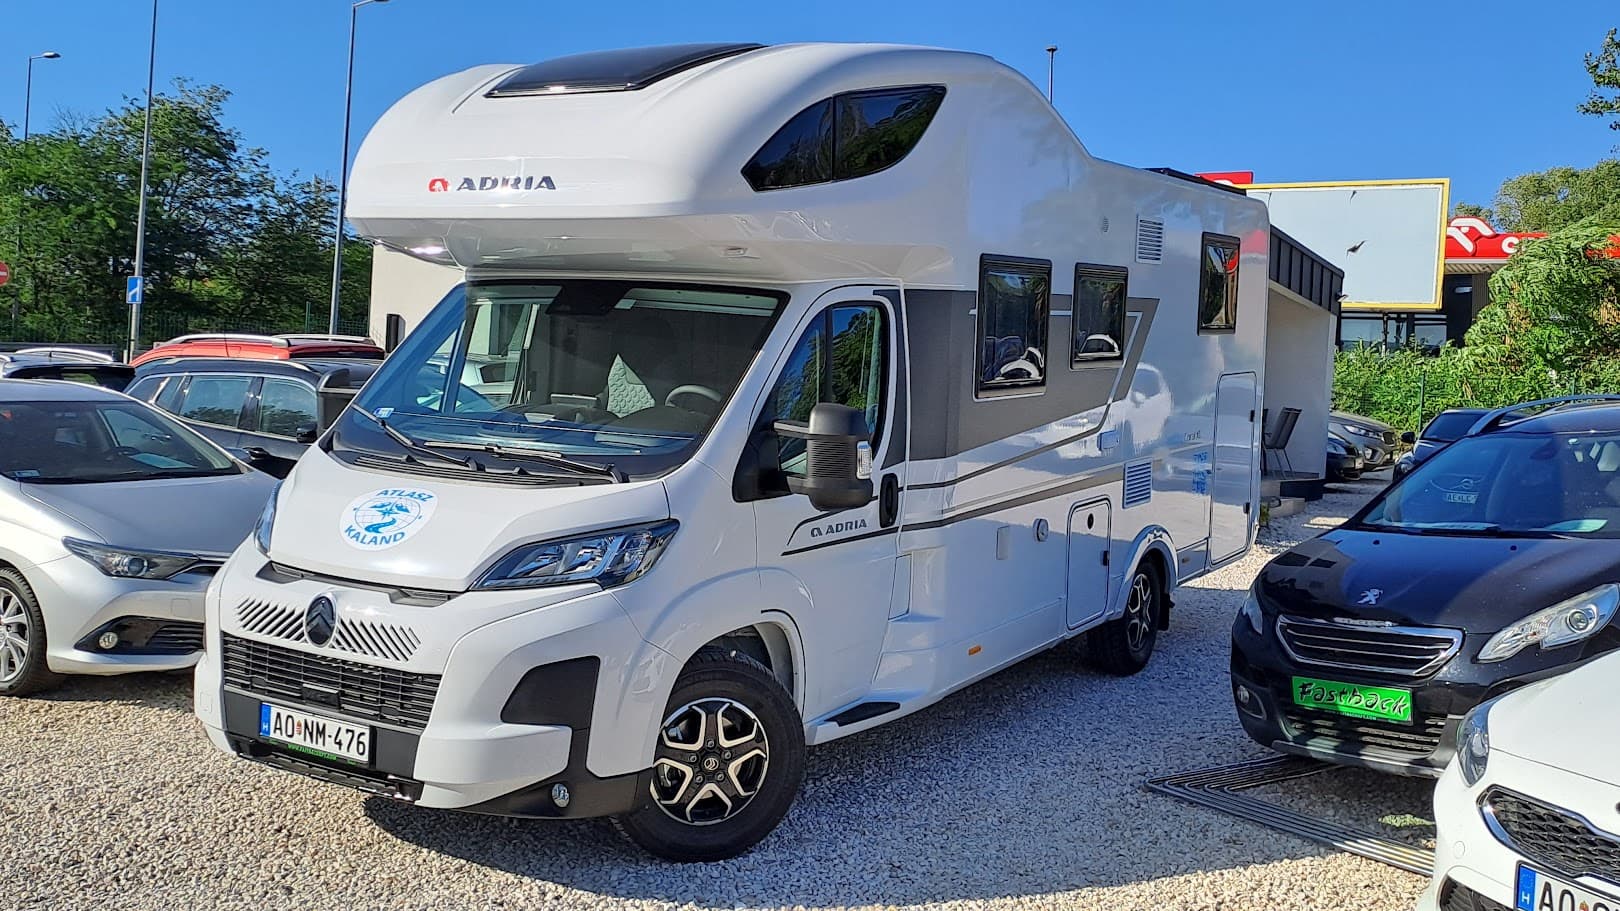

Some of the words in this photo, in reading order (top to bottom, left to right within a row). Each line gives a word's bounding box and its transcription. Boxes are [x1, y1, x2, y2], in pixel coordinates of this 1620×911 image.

[456, 175, 556, 191] ADRIA
[376, 489, 434, 502] ATLASZ
[825, 519, 867, 535] ADRIA
[344, 525, 406, 546] KALAND
[1298, 682, 1407, 716] Fastback
[263, 723, 269, 731] H
[273, 711, 295, 739] AO
[303, 718, 366, 756] NM-476
[1521, 891, 1530, 905] H
